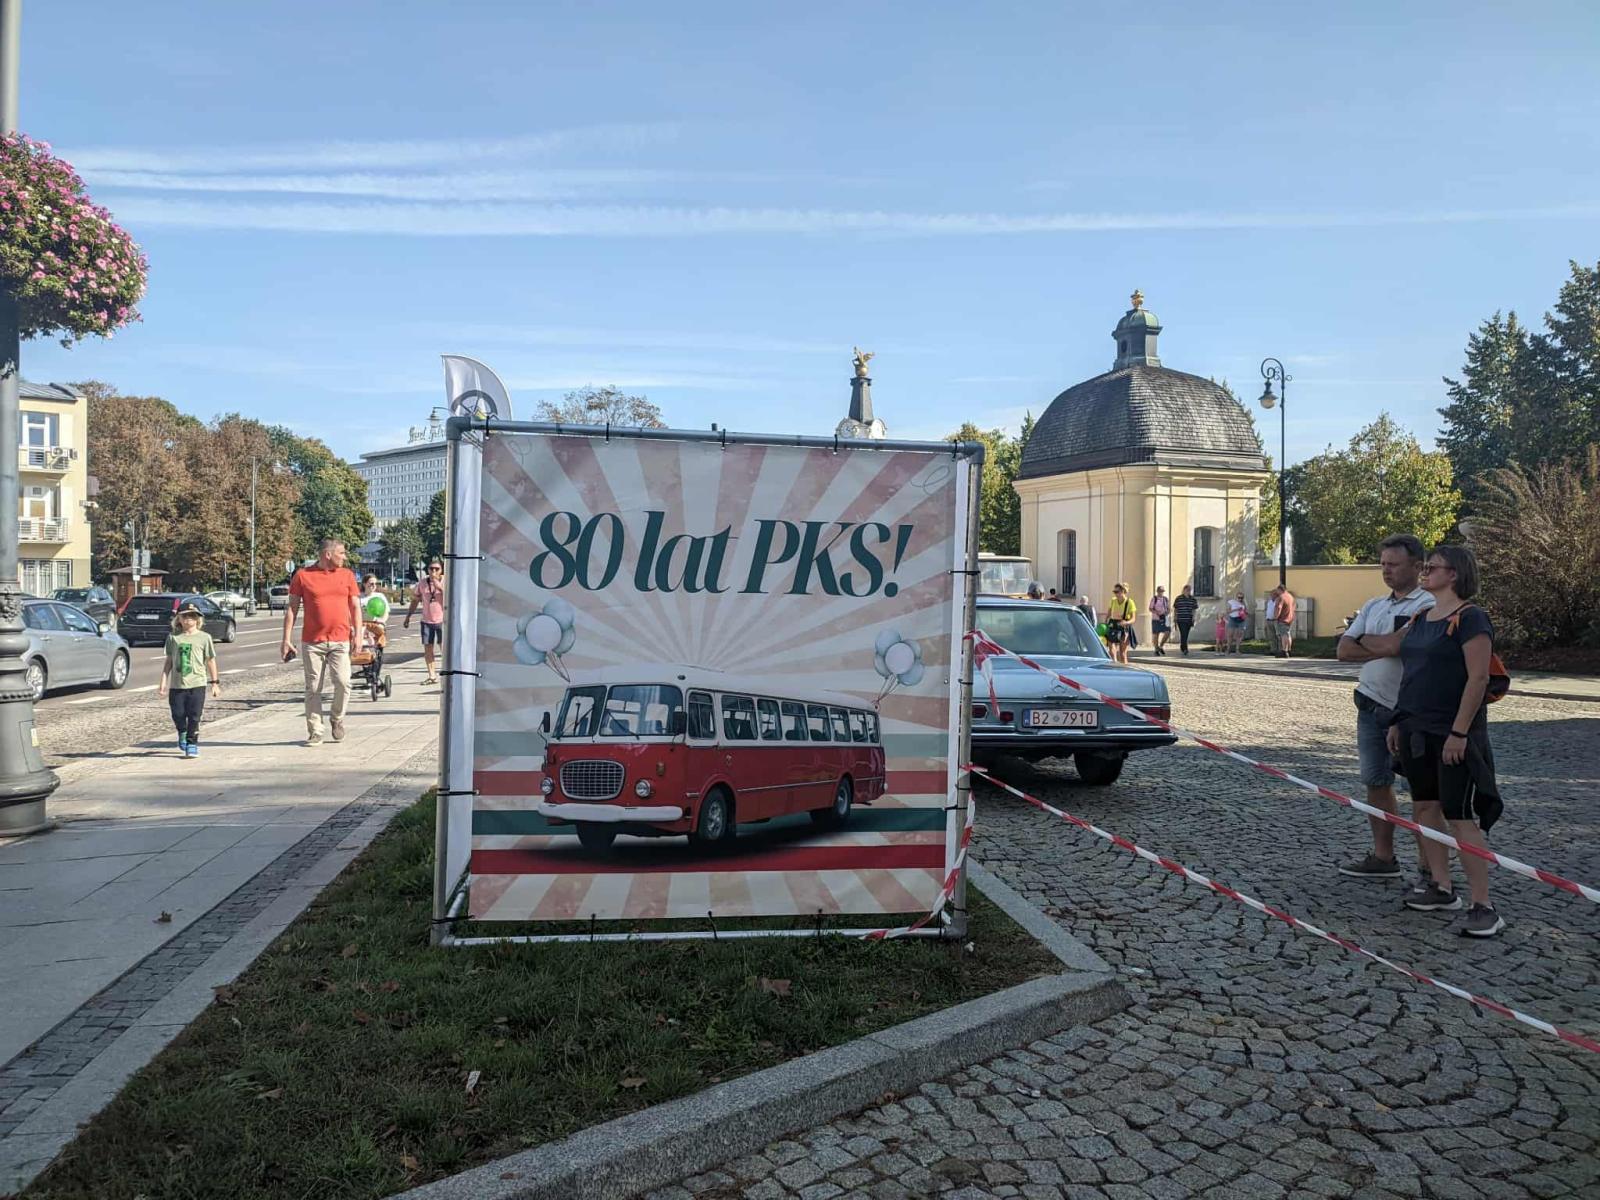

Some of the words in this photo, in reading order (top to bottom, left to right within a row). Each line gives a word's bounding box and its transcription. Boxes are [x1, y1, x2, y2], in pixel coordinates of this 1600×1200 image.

[529, 511, 625, 591] 80
[634, 510, 738, 594] lat
[737, 518, 914, 598] PKS!
[1032, 711, 1049, 725] B2
[1062, 711, 1093, 725] 7910
